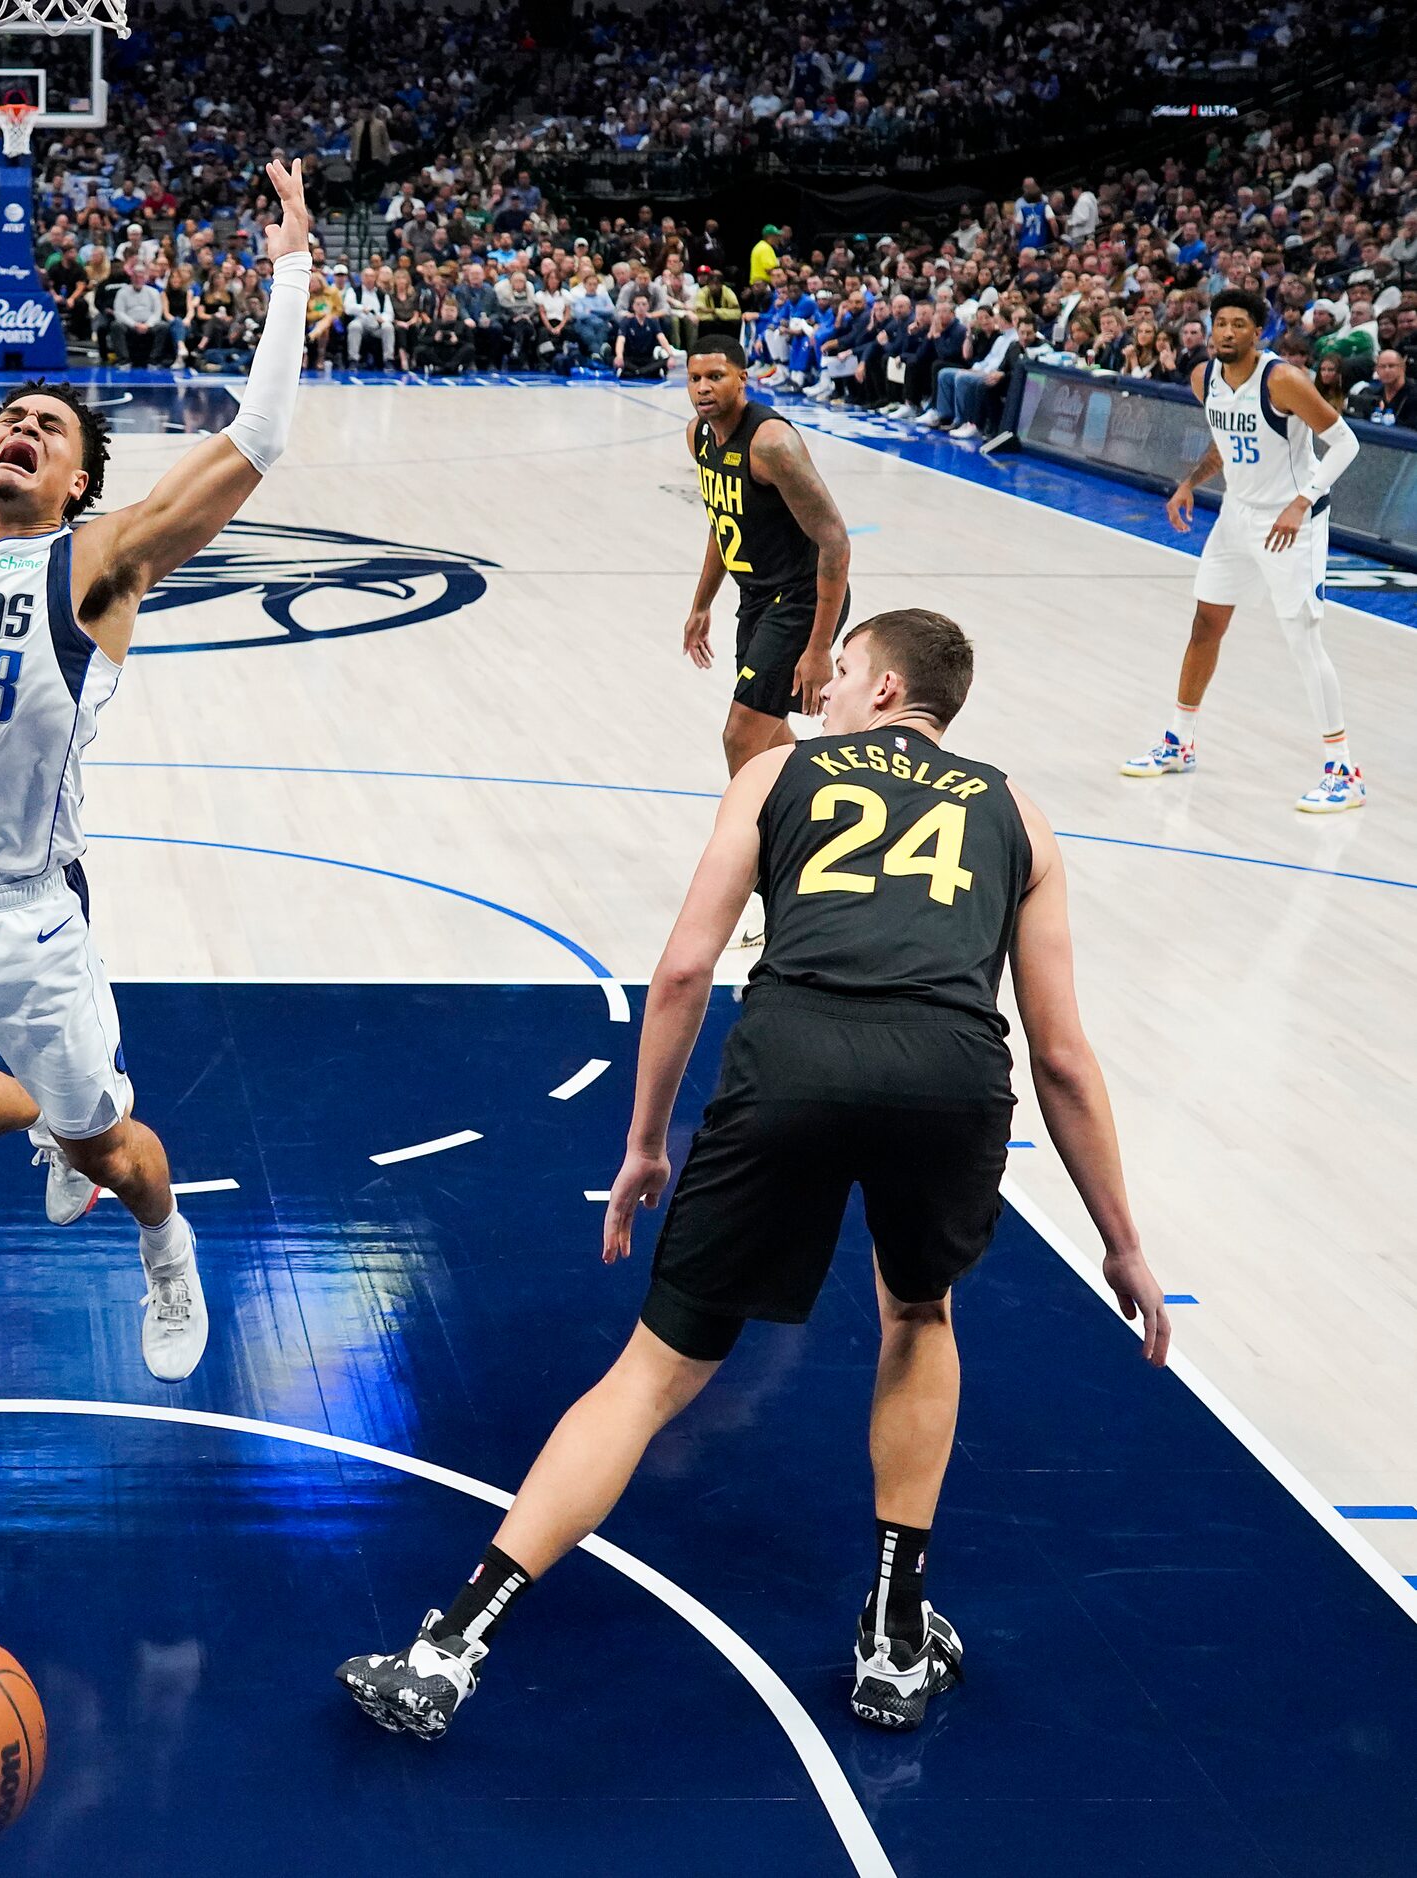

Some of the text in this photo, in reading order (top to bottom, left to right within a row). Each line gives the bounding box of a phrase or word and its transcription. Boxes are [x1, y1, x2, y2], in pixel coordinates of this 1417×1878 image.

[1208, 408, 1257, 433] DALLAS
[1230, 435, 1260, 464] 35
[697, 463, 744, 515] UTAH
[810, 744, 988, 801] KESSLER
[796, 783, 973, 906] 24
